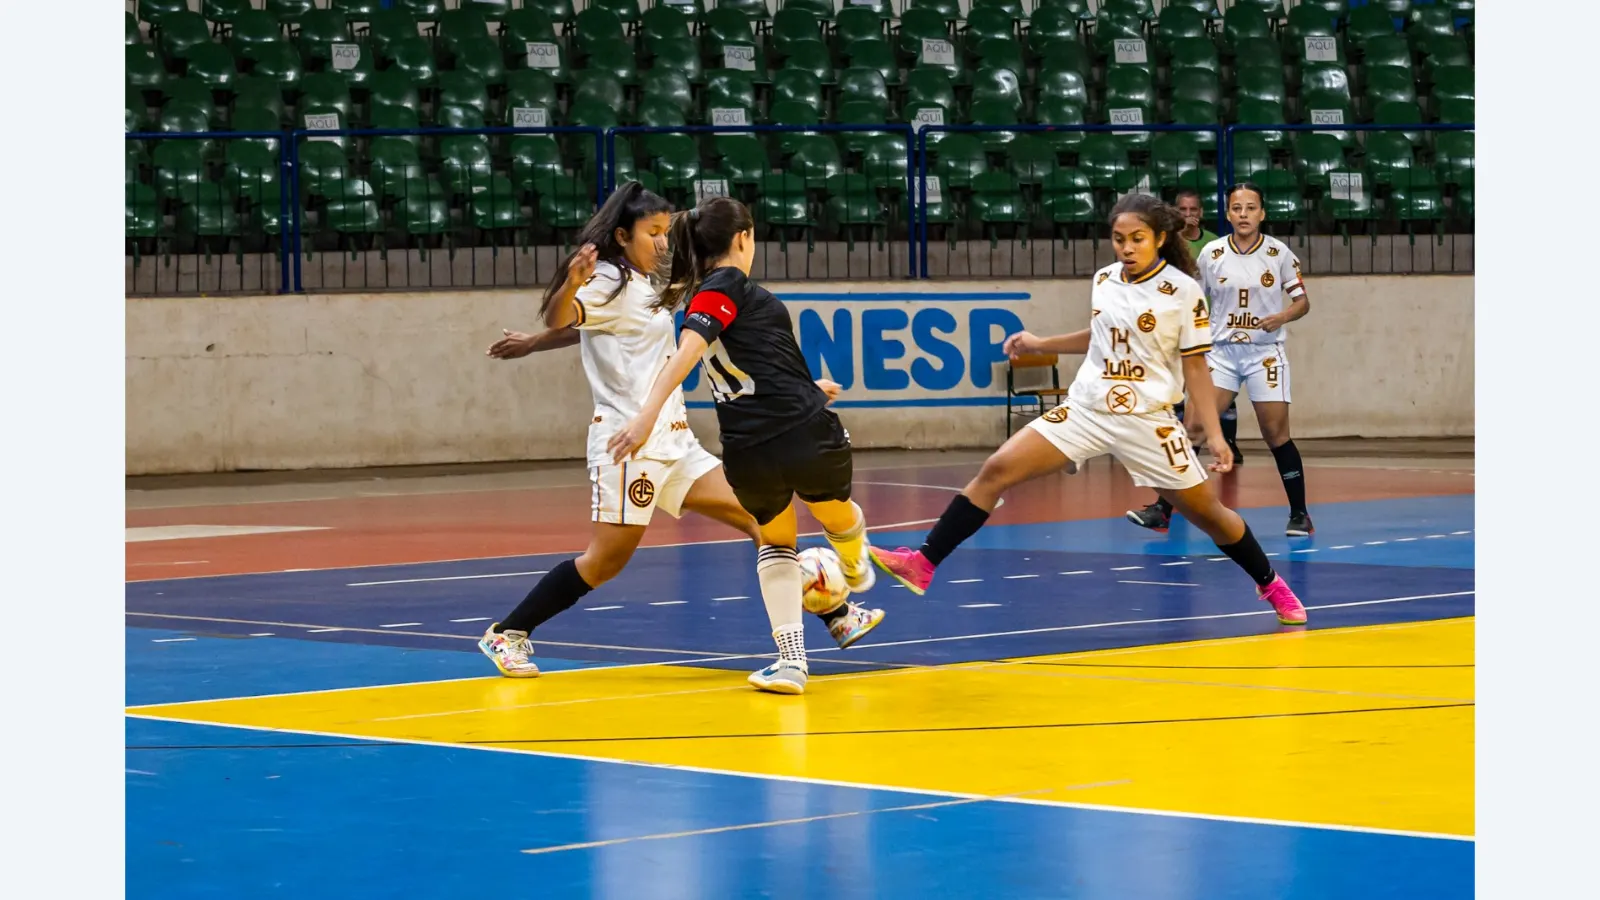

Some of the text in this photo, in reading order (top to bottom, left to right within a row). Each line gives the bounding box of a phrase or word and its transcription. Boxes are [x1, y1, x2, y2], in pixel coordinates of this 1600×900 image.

[925, 43, 952, 53] AQUI
[1117, 43, 1144, 52] AQUI
[1307, 41, 1335, 51] AQUI
[529, 47, 557, 57] AQUI
[515, 113, 544, 123] AQUI
[715, 113, 743, 123] AQUI
[1113, 113, 1140, 122] AQUI
[1314, 115, 1341, 123] AQUI
[307, 119, 337, 129] AQUI
[1332, 178, 1360, 188] AQUI
[1238, 288, 1249, 309] 8
[1110, 327, 1131, 354] 14
[1103, 358, 1145, 378] Julio
[1266, 366, 1278, 382] 8
[1161, 437, 1189, 466] 14
